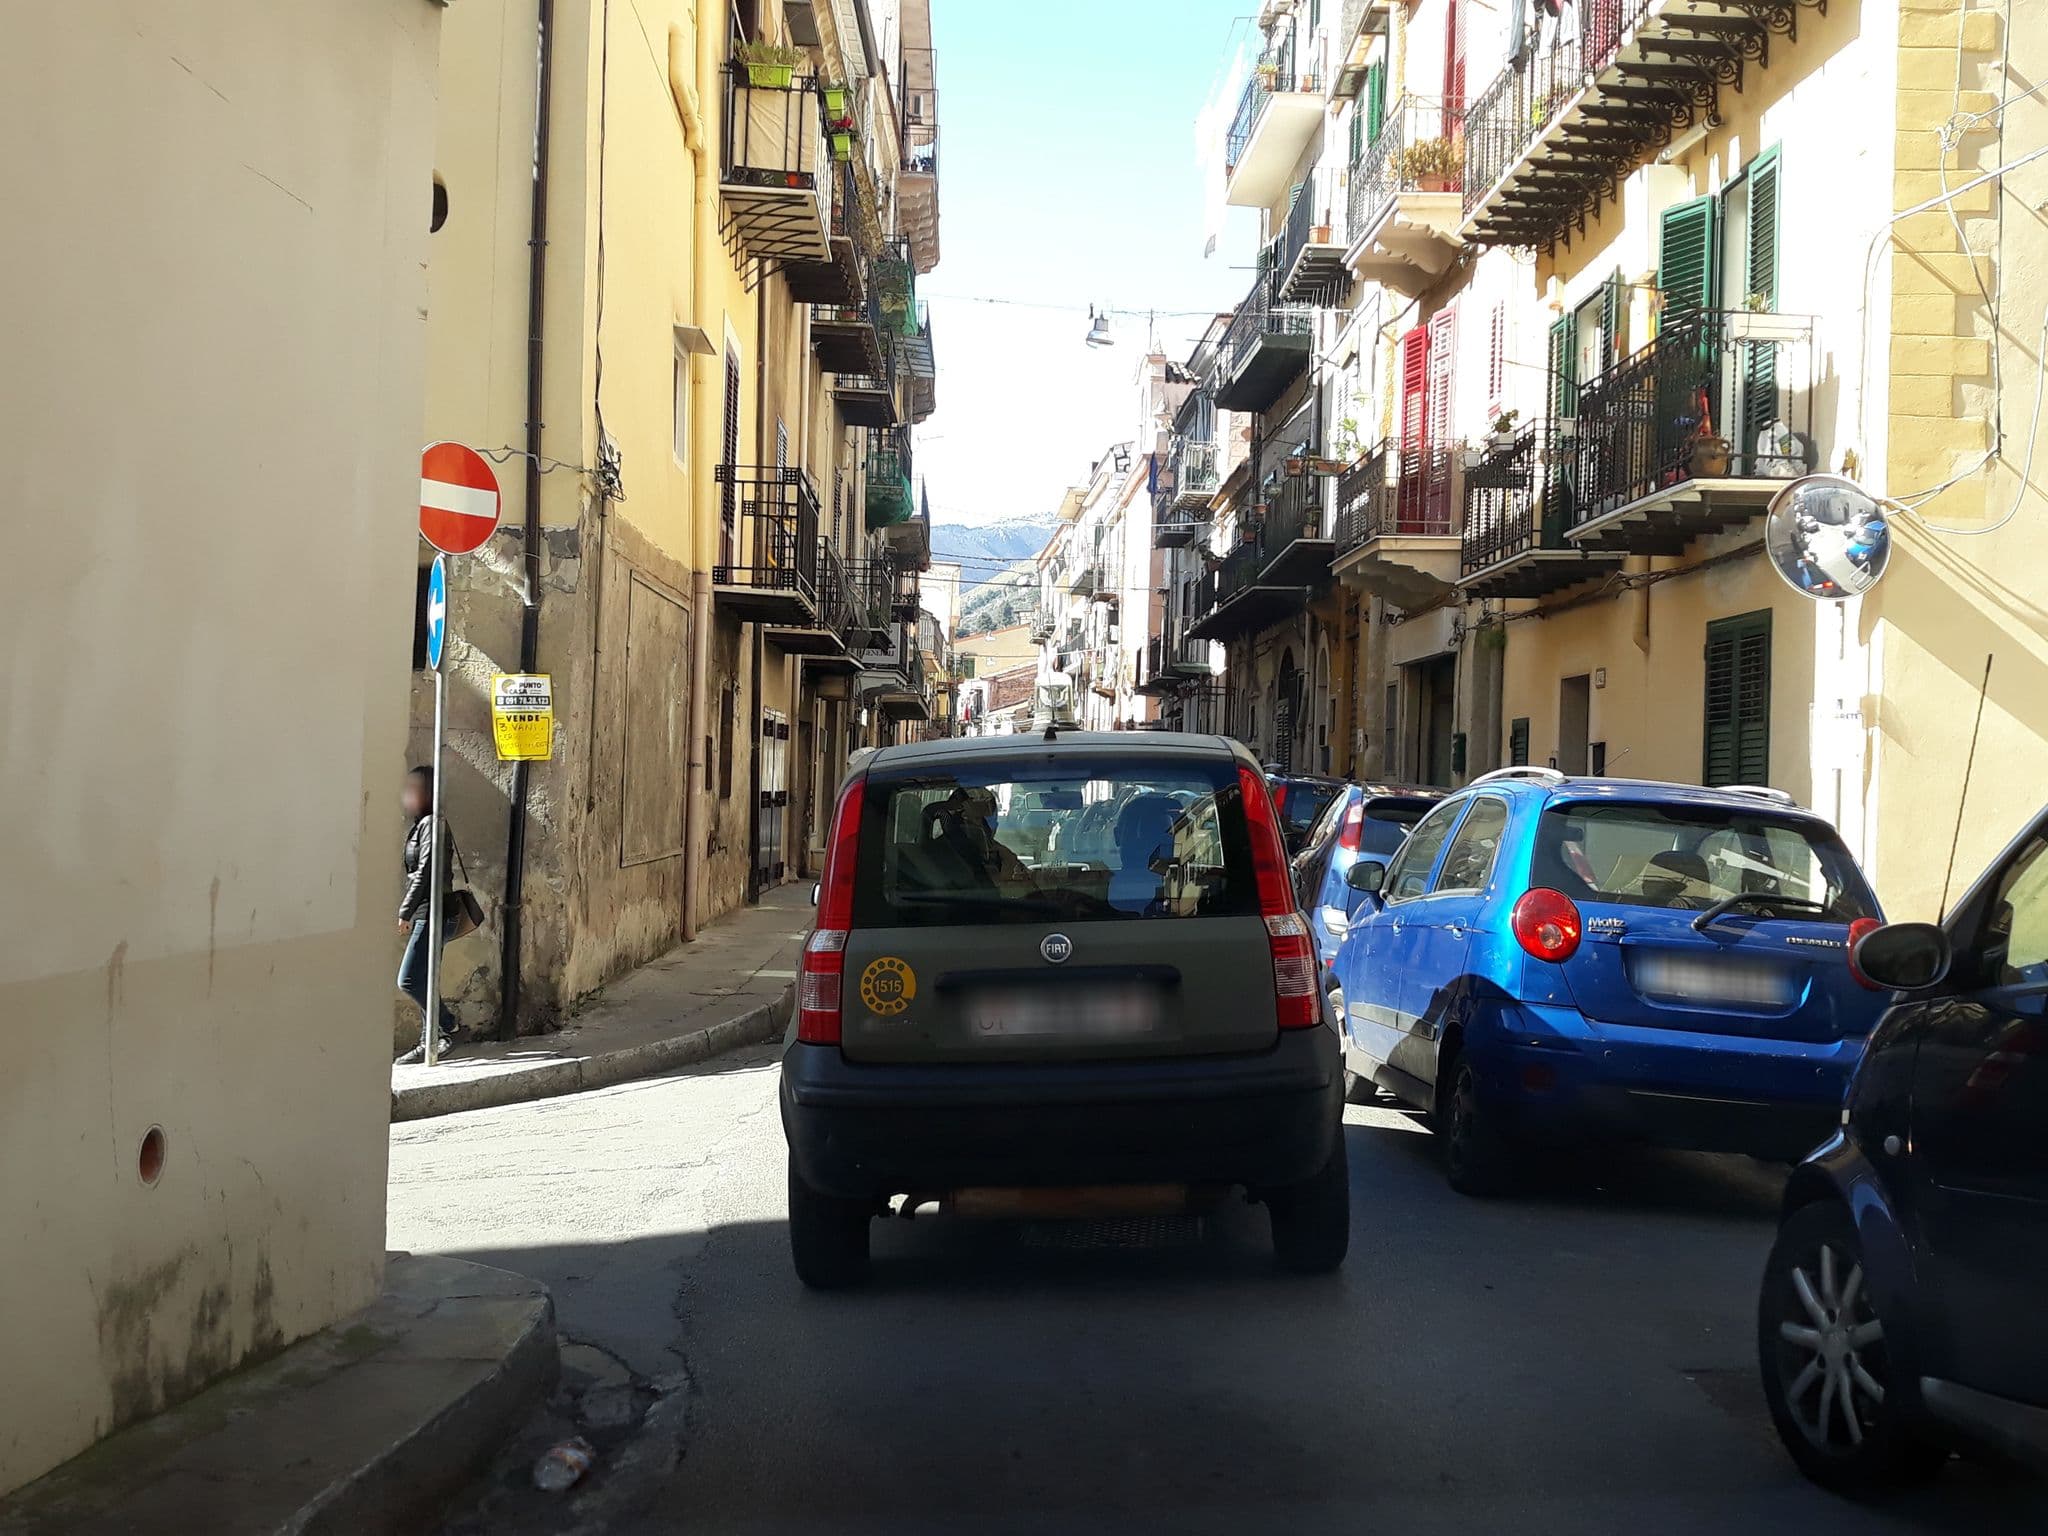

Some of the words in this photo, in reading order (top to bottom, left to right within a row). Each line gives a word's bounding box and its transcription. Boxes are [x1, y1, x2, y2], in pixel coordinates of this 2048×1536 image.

[506, 714, 540, 722] VENDE
[1046, 943, 1067, 954] FIAT
[874, 979, 902, 993] 1515
